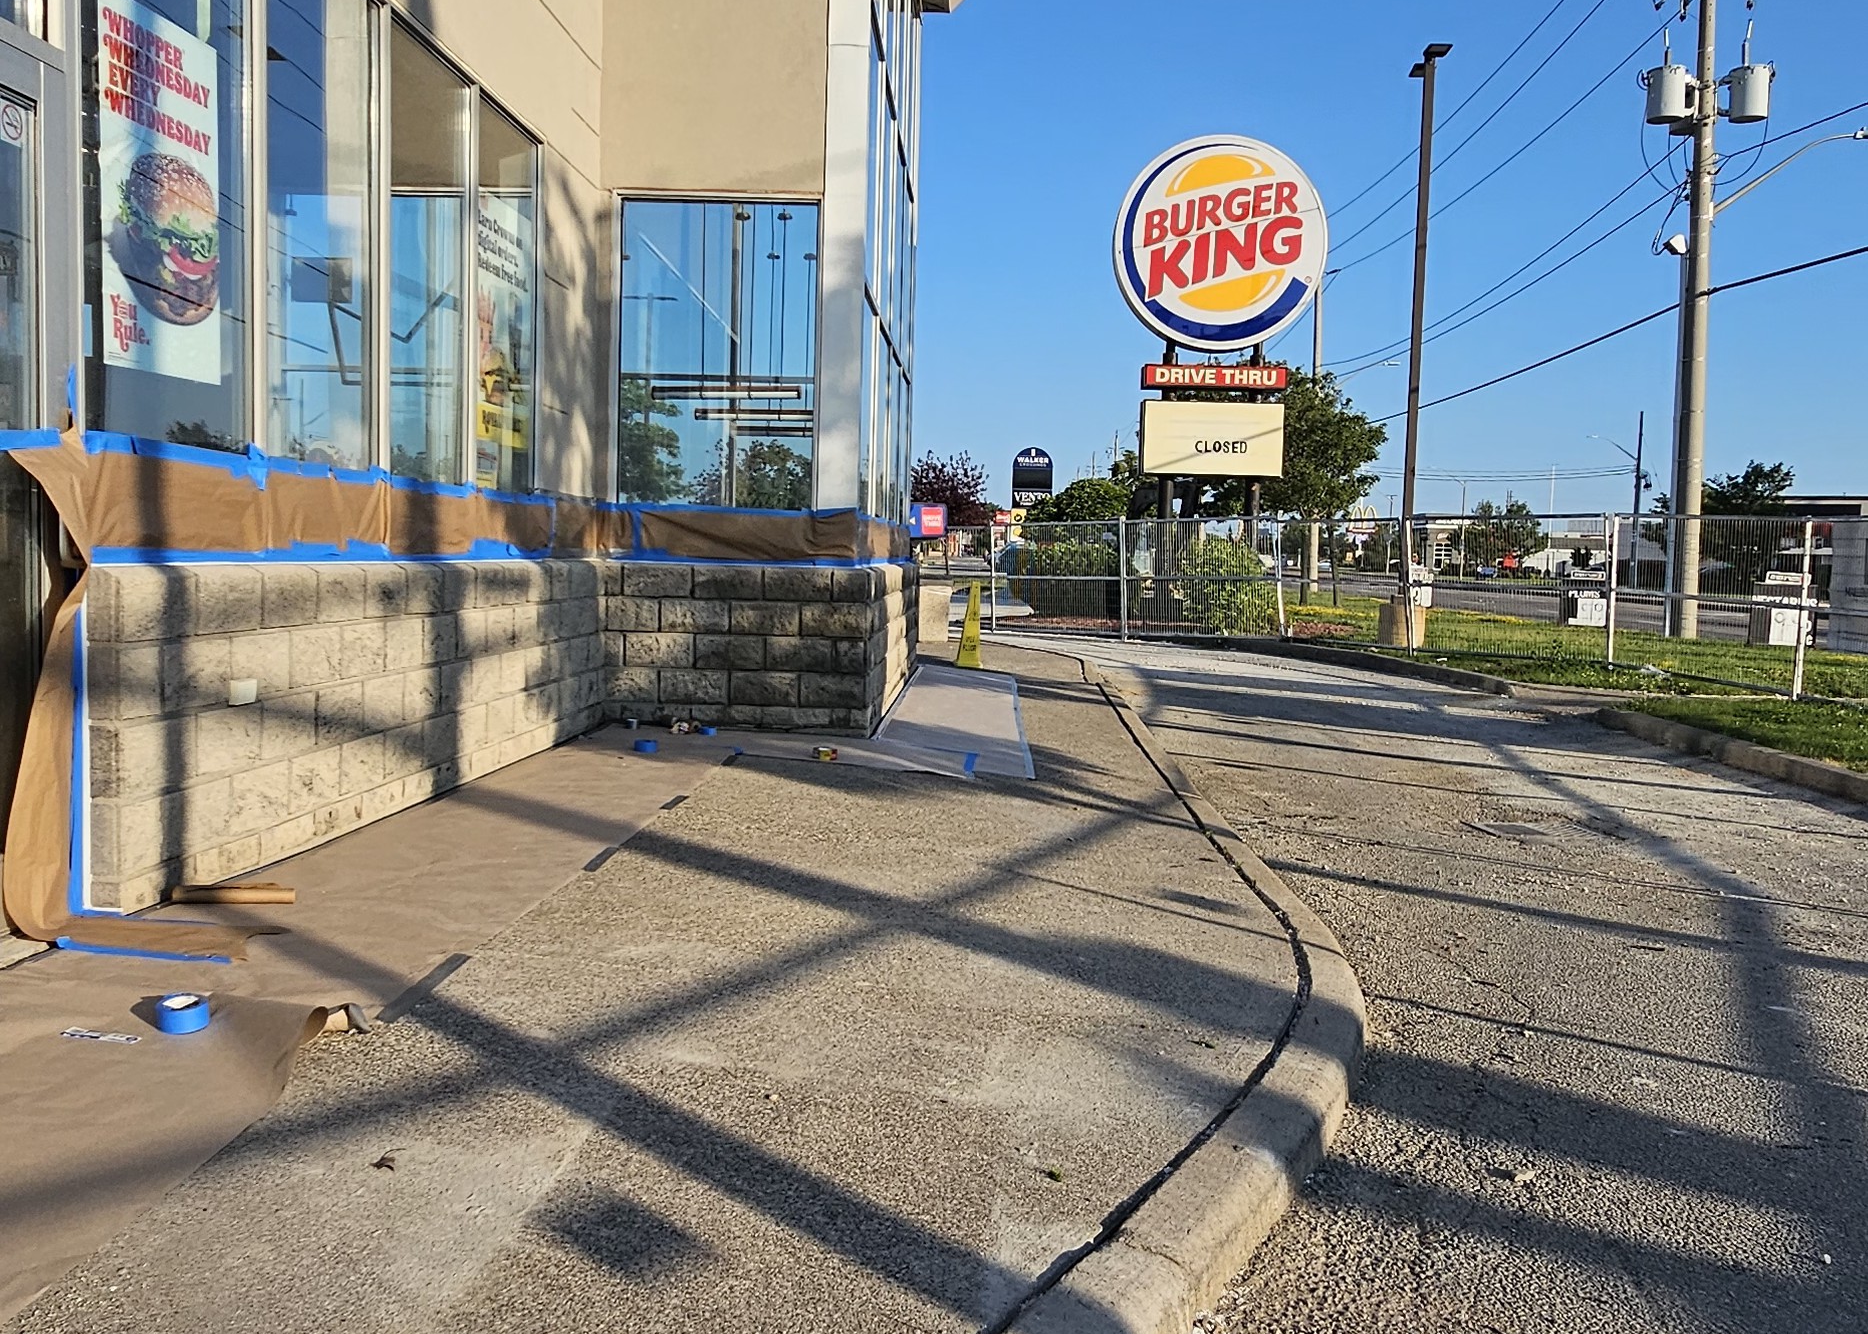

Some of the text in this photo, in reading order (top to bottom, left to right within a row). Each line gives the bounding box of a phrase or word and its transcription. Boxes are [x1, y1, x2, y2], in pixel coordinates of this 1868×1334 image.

[103, 7, 184, 71] WHOPPER
[103, 34, 210, 109] WHEDNESDAY
[109, 61, 161, 107] EVERY
[104, 87, 211, 156] WHEDNESDAY
[1143, 181, 1298, 248] BURGER
[1147, 216, 1304, 299] KING
[110, 293, 138, 321] You
[113, 317, 151, 353] Rule.
[1155, 367, 1278, 387] DRIVE THRU
[1017, 456, 1050, 464] WALKER
[1194, 440, 1248, 455] CLOSED
